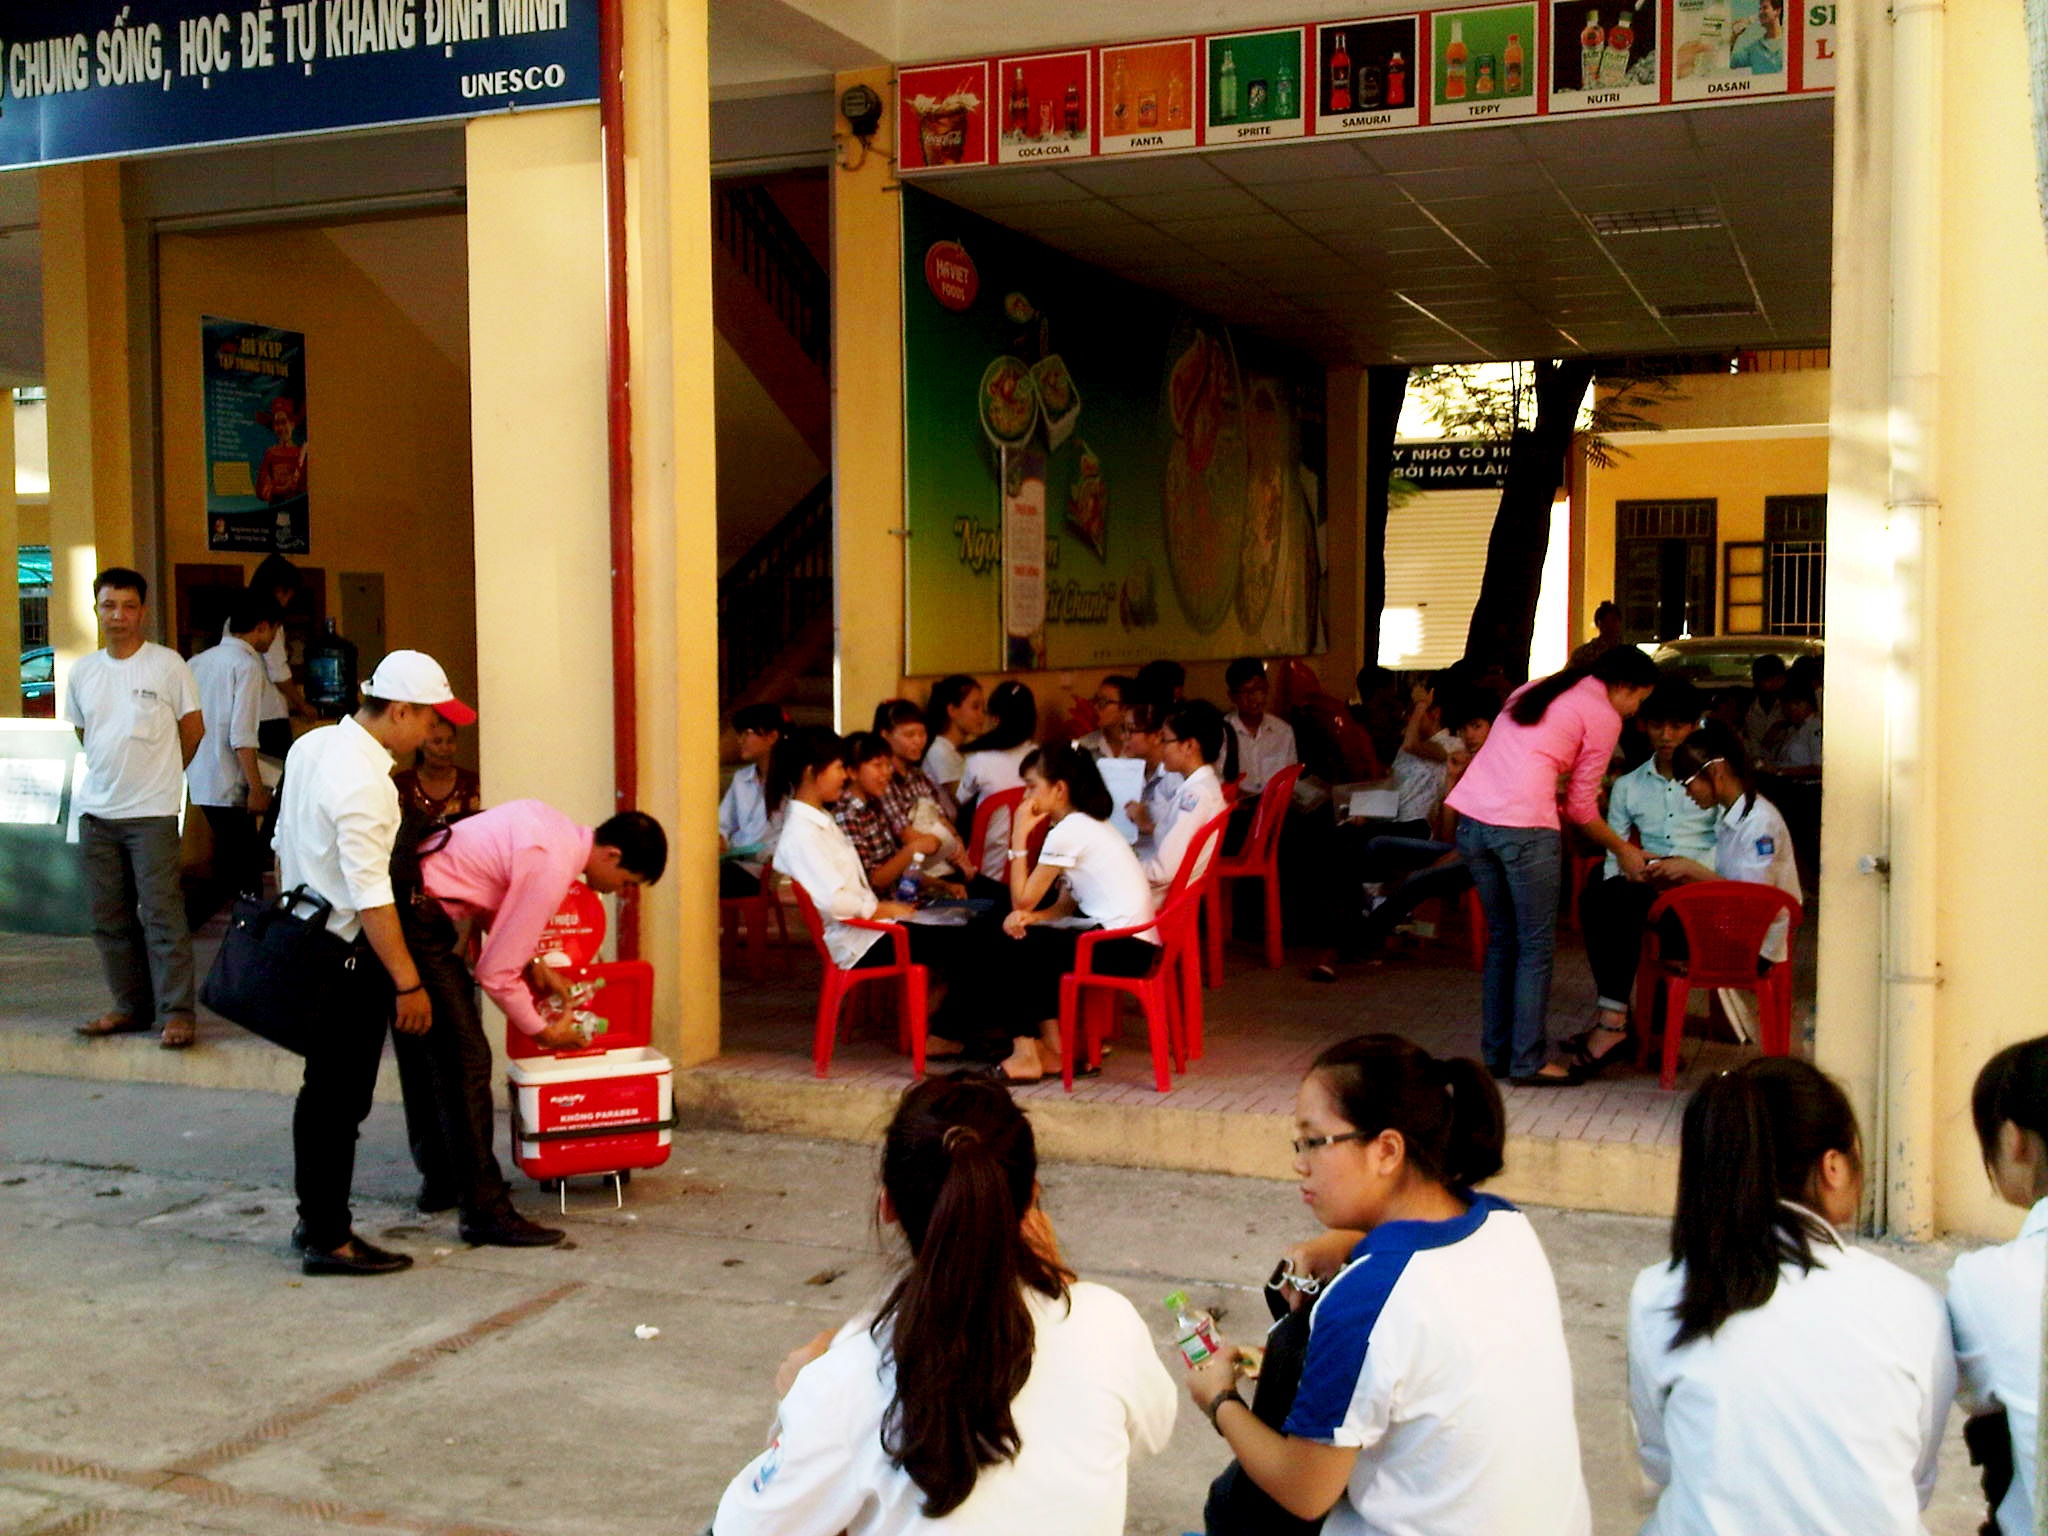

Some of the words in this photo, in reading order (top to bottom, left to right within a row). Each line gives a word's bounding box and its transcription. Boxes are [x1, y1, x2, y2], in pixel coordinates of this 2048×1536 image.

[9, 33, 90, 99] CHUNG
[96, 5, 173, 91] SỐNG,
[180, 13, 231, 89] HỌC
[282, 0, 319, 76] TỰ
[424, 0, 490, 58] ĐỊNH
[461, 64, 566, 98] UNESCO
[1707, 80, 1750, 94] DASANI
[1587, 93, 1620, 104] NUTRI
[1469, 104, 1500, 115] TEPPY
[1342, 115, 1391, 128] SAMURAI
[1237, 126, 1271, 137] SPRITE
[1131, 136, 1163, 147] FANTA
[1430, 465, 1469, 477] HAY
